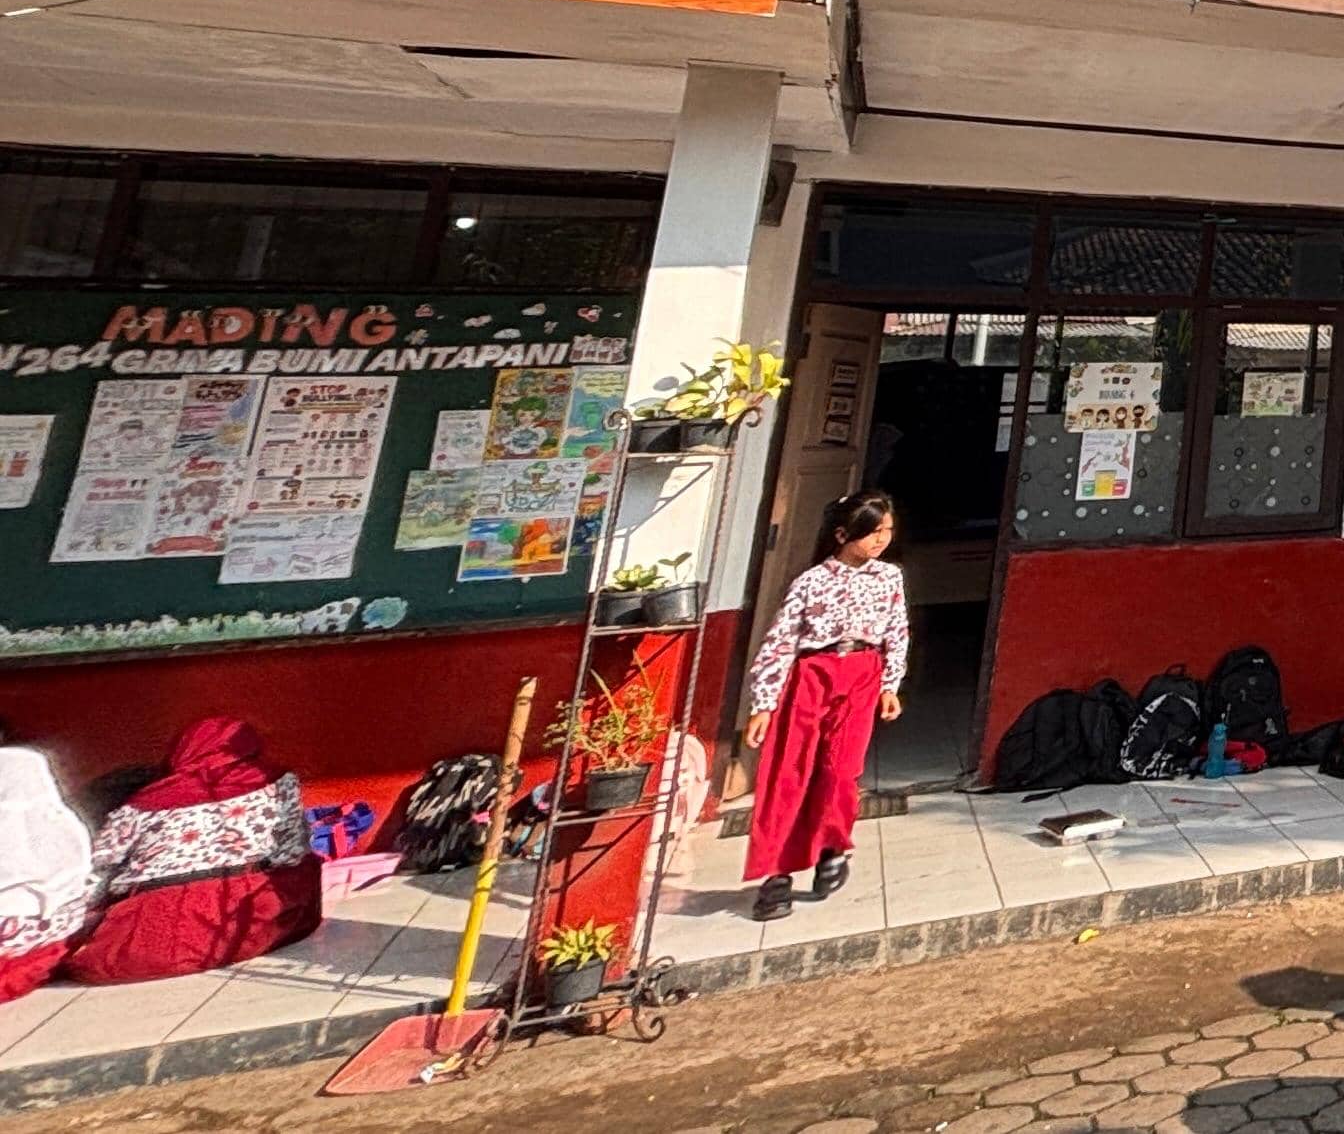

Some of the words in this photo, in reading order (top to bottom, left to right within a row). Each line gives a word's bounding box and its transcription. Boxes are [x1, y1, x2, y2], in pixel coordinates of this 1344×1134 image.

[102, 303, 398, 346] MADING
[111, 348, 246, 374] GRIYA
[247, 348, 369, 374] BUMI
[364, 342, 570, 372] ANTAPANI
[310, 384, 347, 394] STOP
